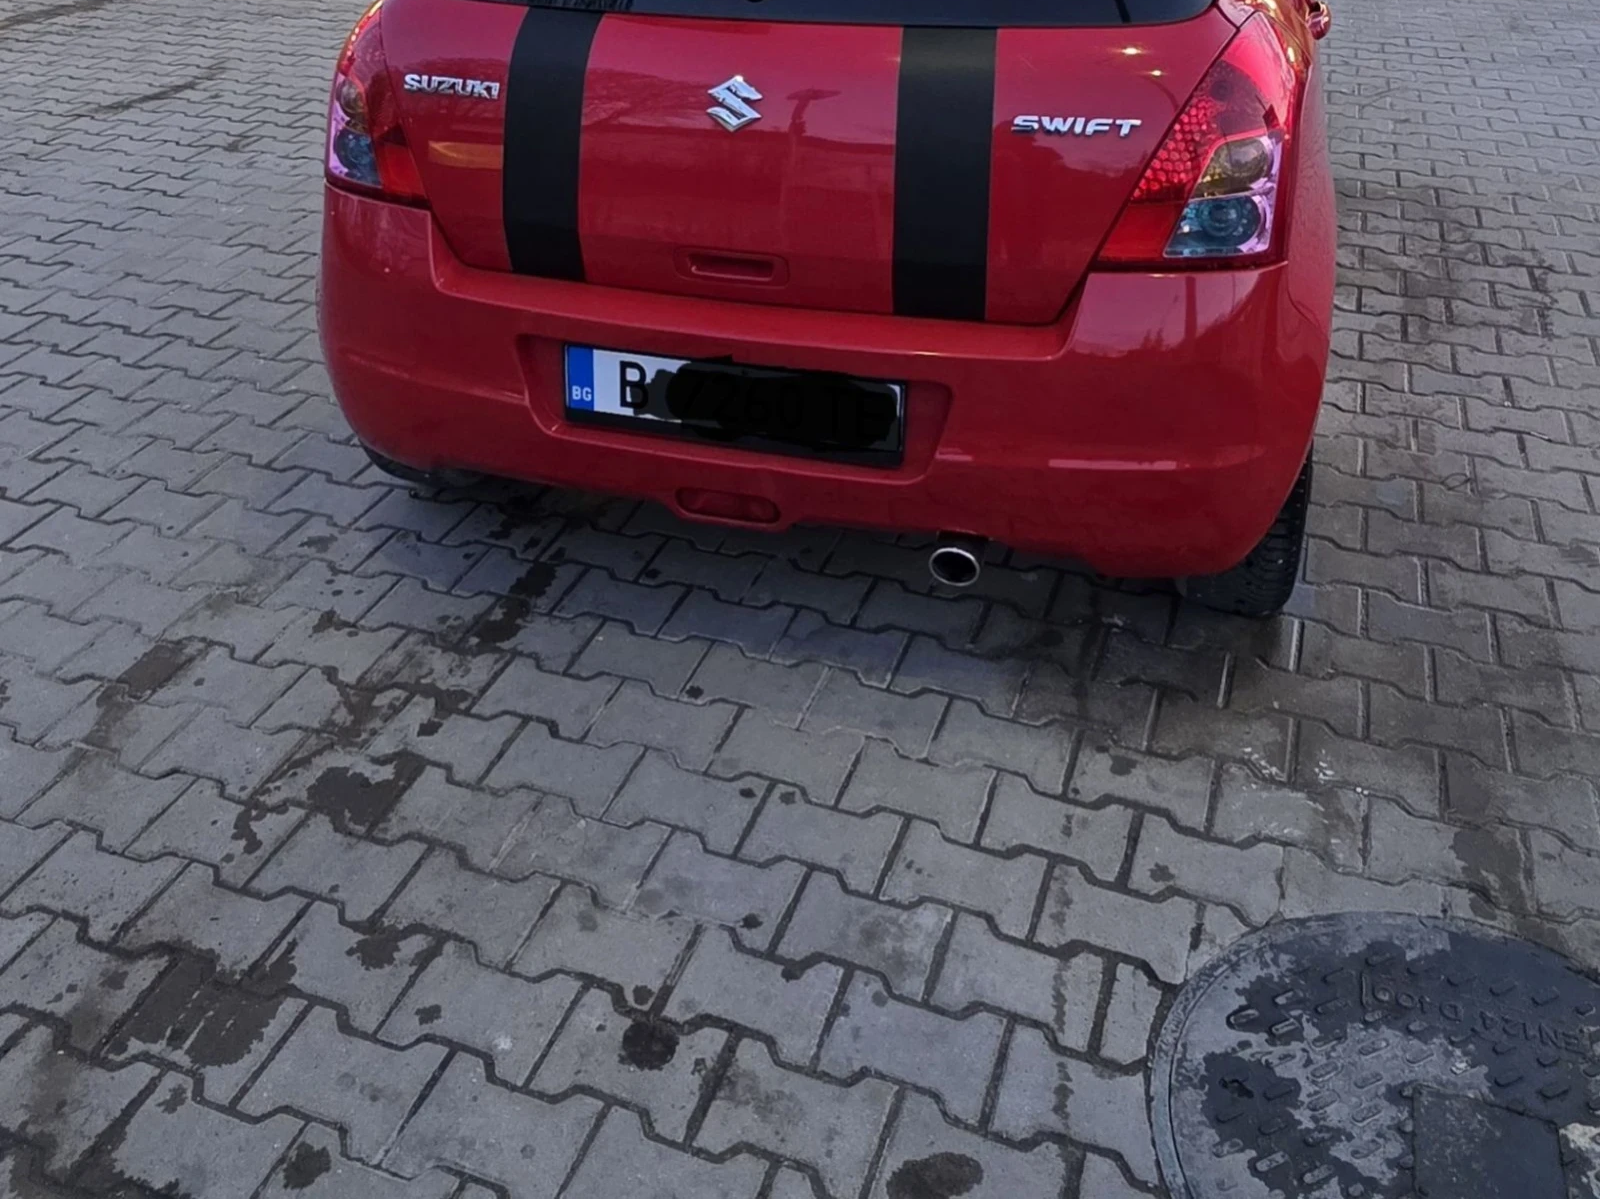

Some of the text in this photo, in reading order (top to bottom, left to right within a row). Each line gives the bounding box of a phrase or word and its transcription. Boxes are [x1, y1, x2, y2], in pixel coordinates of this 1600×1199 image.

[404, 74, 500, 99] SUZUKI
[1011, 116, 1142, 137] SWIFT
[572, 385, 592, 401] BG
